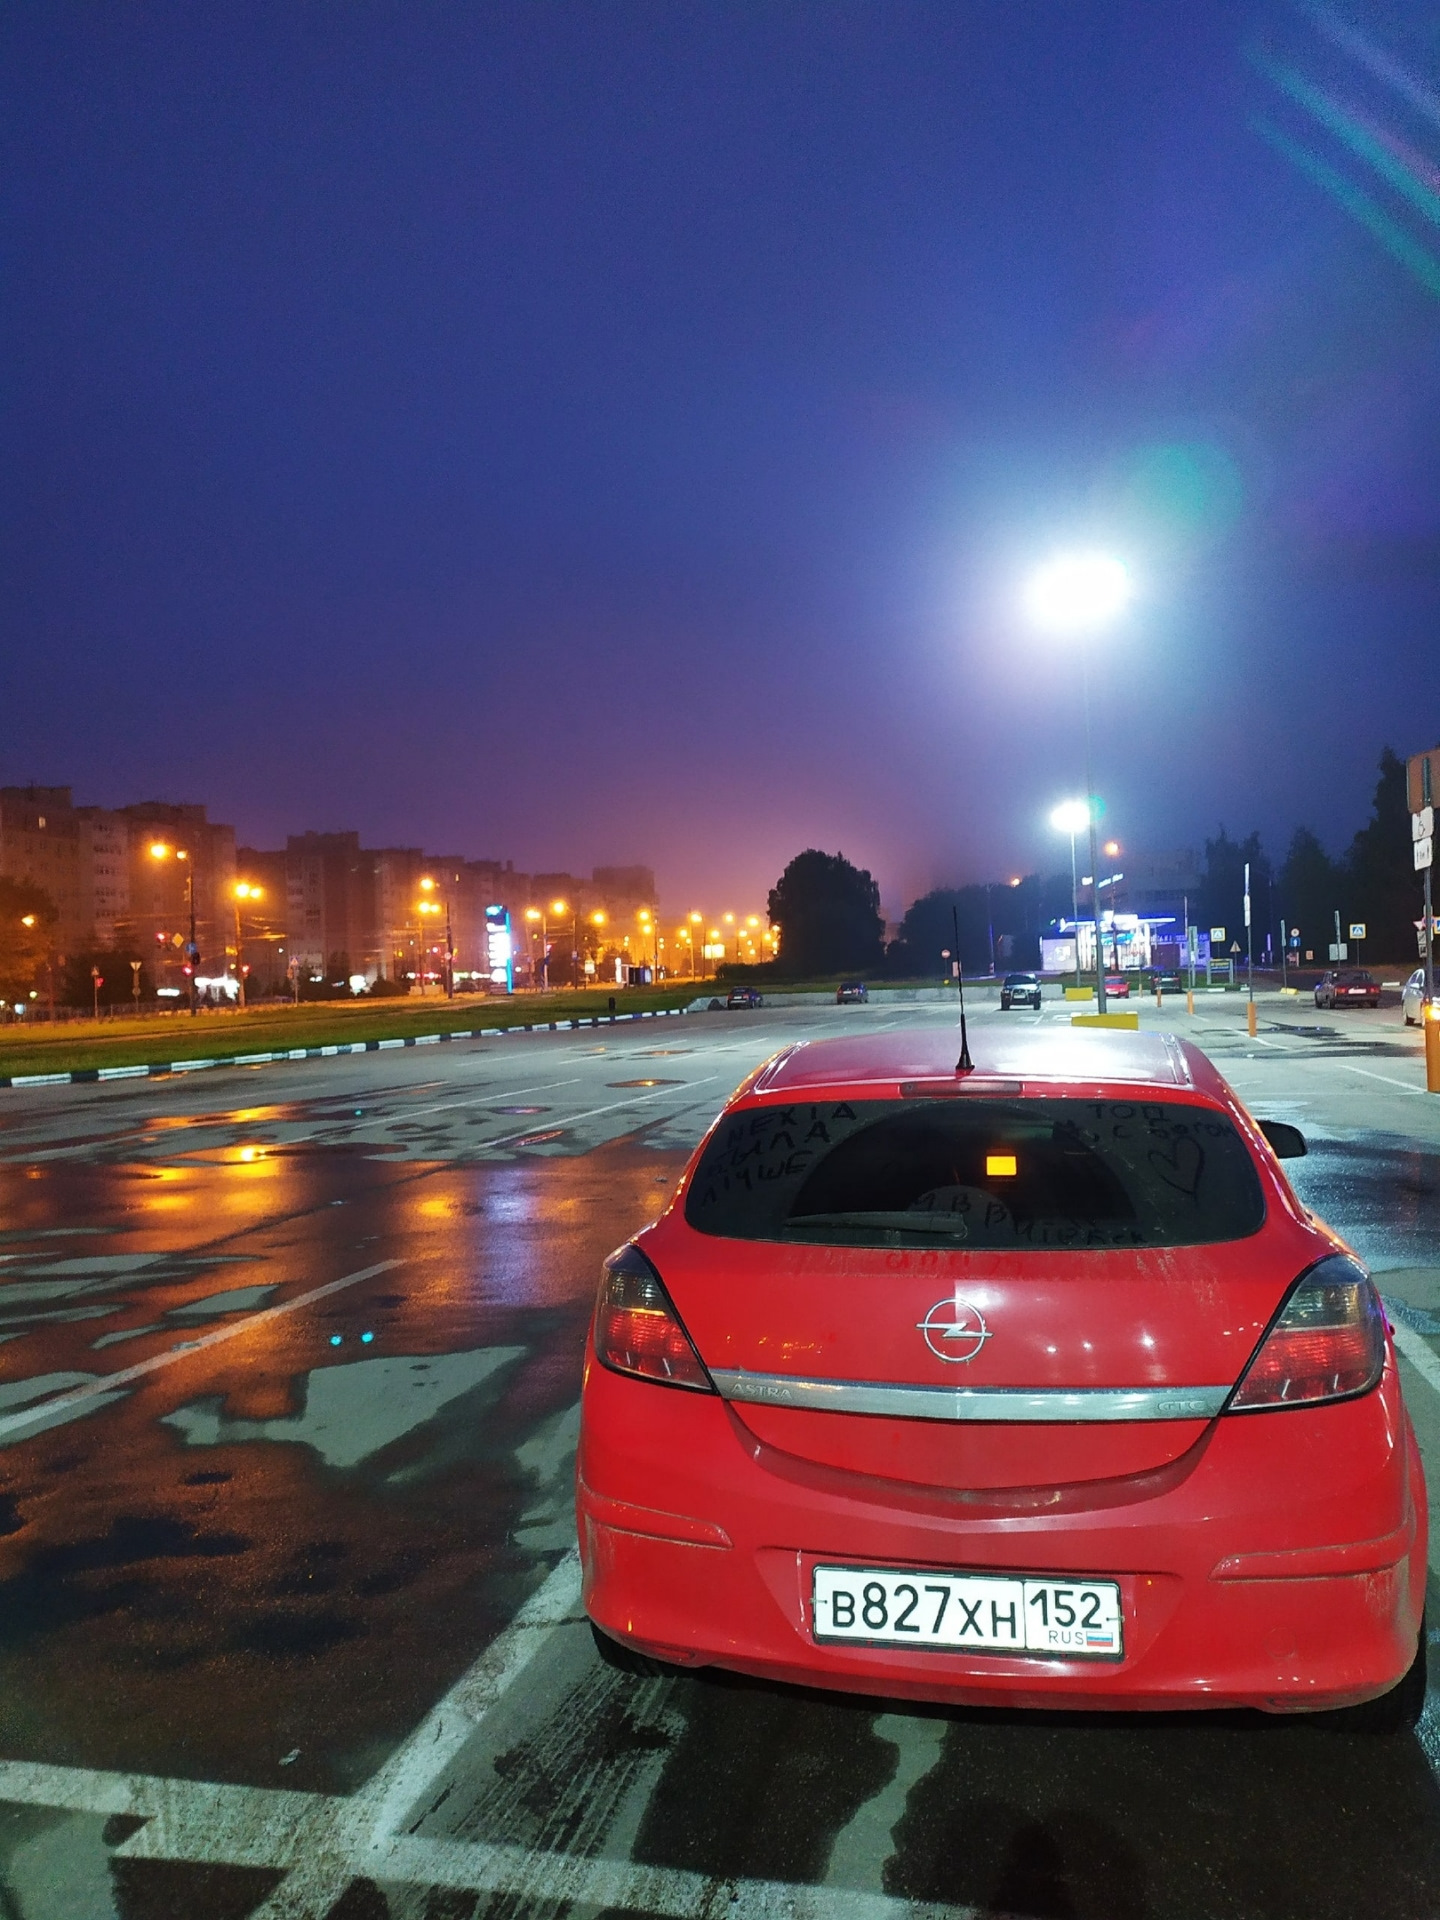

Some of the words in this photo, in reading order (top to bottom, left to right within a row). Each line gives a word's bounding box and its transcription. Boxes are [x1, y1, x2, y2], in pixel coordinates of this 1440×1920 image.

[727, 1101, 857, 1149] NEXIA
[731, 1382, 793, 1401] ASTRA
[831, 1581, 1018, 1639] В827ХН
[1029, 1589, 1103, 1629] 152
[1048, 1630, 1084, 1645] RUS
